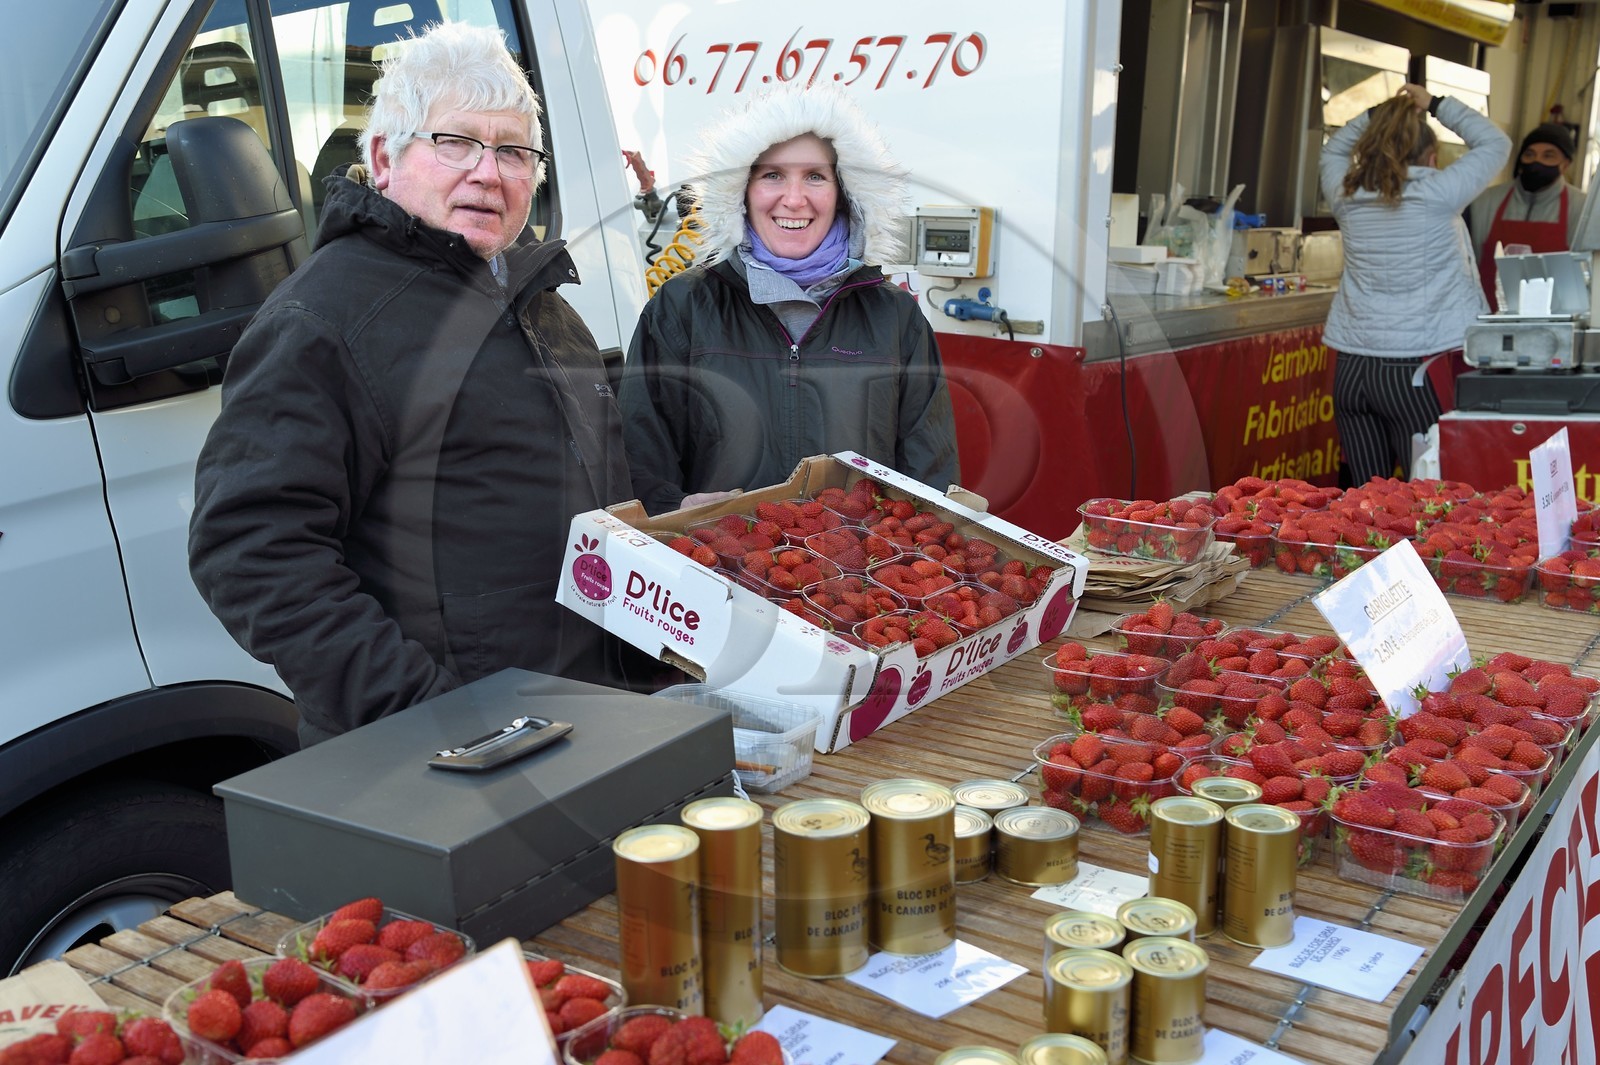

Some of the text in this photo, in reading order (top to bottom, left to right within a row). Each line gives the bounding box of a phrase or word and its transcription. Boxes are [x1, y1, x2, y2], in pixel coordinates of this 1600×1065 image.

[633, 26, 988, 95] 06.77.67.57.70
[1262, 340, 1328, 384] Jambon
[1023, 534, 1076, 558] D'lice
[580, 560, 607, 582] D'lice
[626, 570, 700, 630] D'lice
[1363, 580, 1410, 621] GARIGUETTE
[623, 597, 694, 645] Fruits rouges
[946, 633, 1003, 677] D'lice
[940, 671, 966, 691] Fruits
[966, 657, 994, 677] rouges
[897, 889, 922, 900] BLOC
[926, 888, 937, 899] DE
[824, 907, 849, 921] BLOC
[881, 902, 893, 914] DE
[896, 903, 937, 917] CANARD
[1264, 908, 1275, 917] DE
[807, 926, 820, 937] DE
